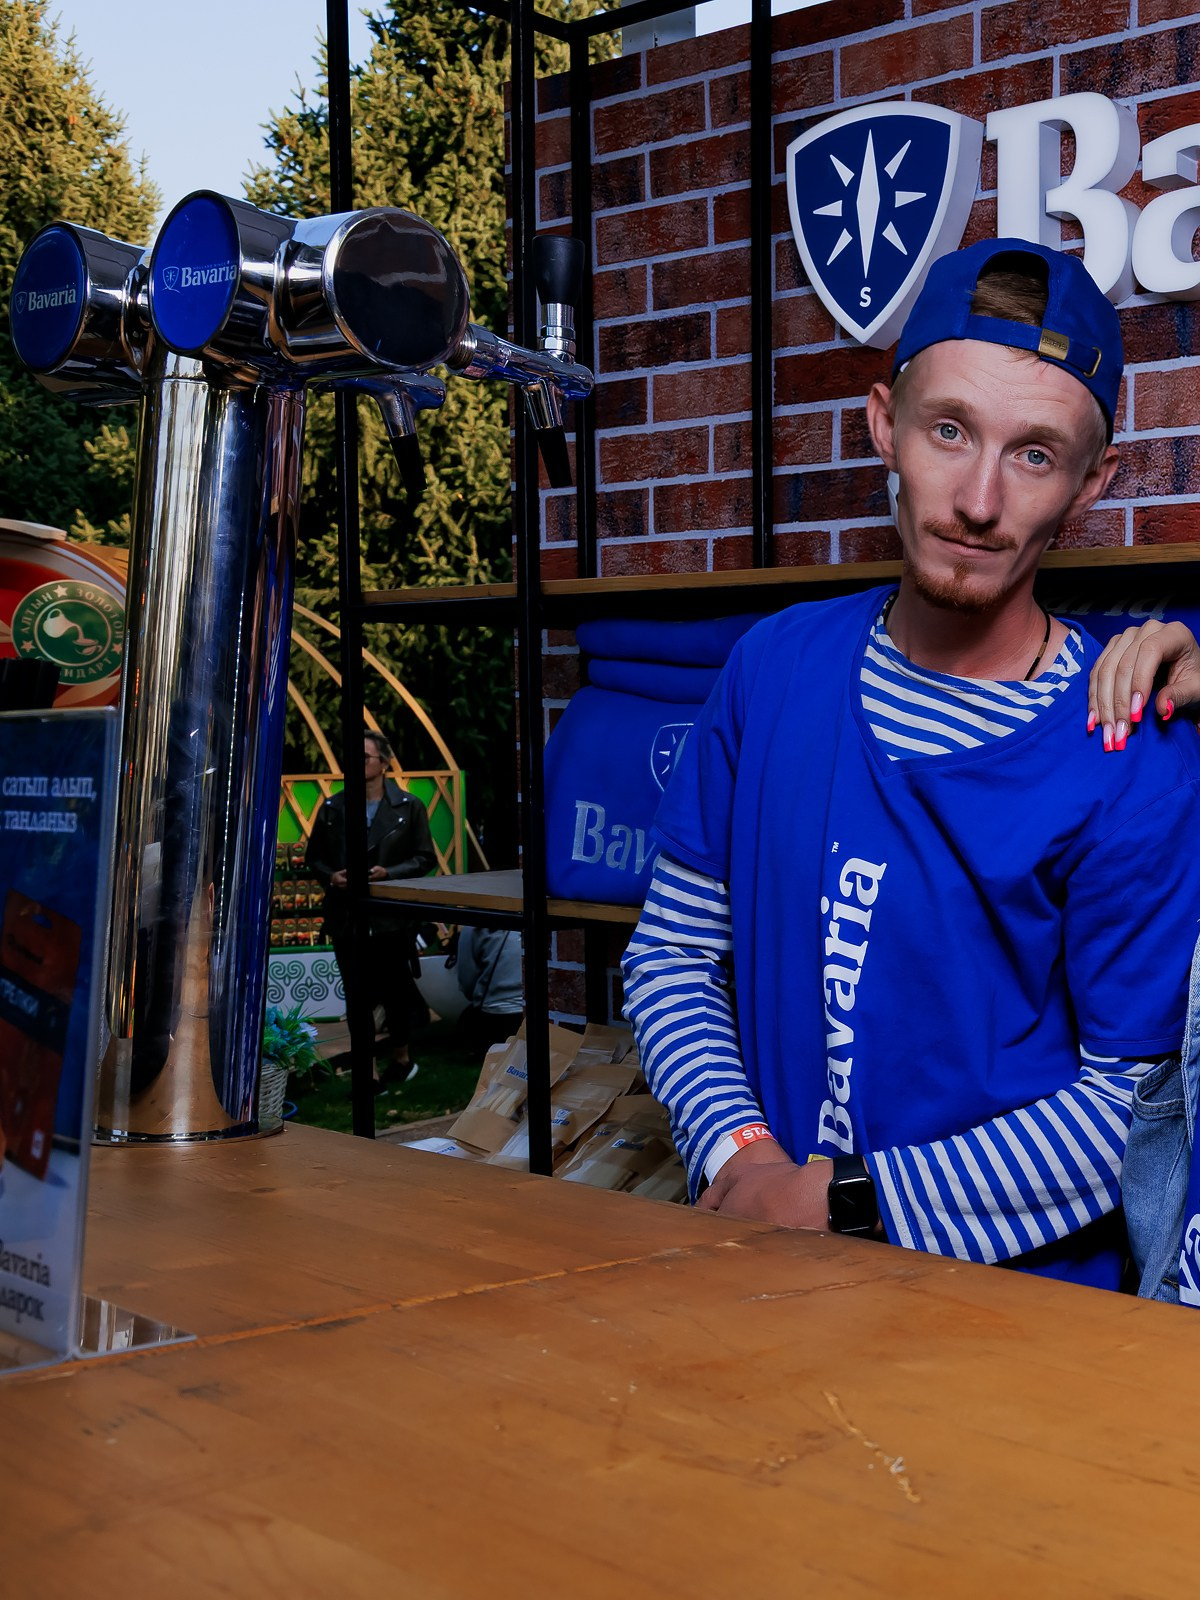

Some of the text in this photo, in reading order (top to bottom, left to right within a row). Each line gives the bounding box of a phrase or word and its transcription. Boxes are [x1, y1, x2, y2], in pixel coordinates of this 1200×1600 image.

[181, 260, 237, 288] Bavaria
[28, 283, 77, 312] Bavaria
[2, 776, 49, 797] сатып
[818, 857, 887, 1154] Bavaria
[0, 1239, 50, 1287] avaria
